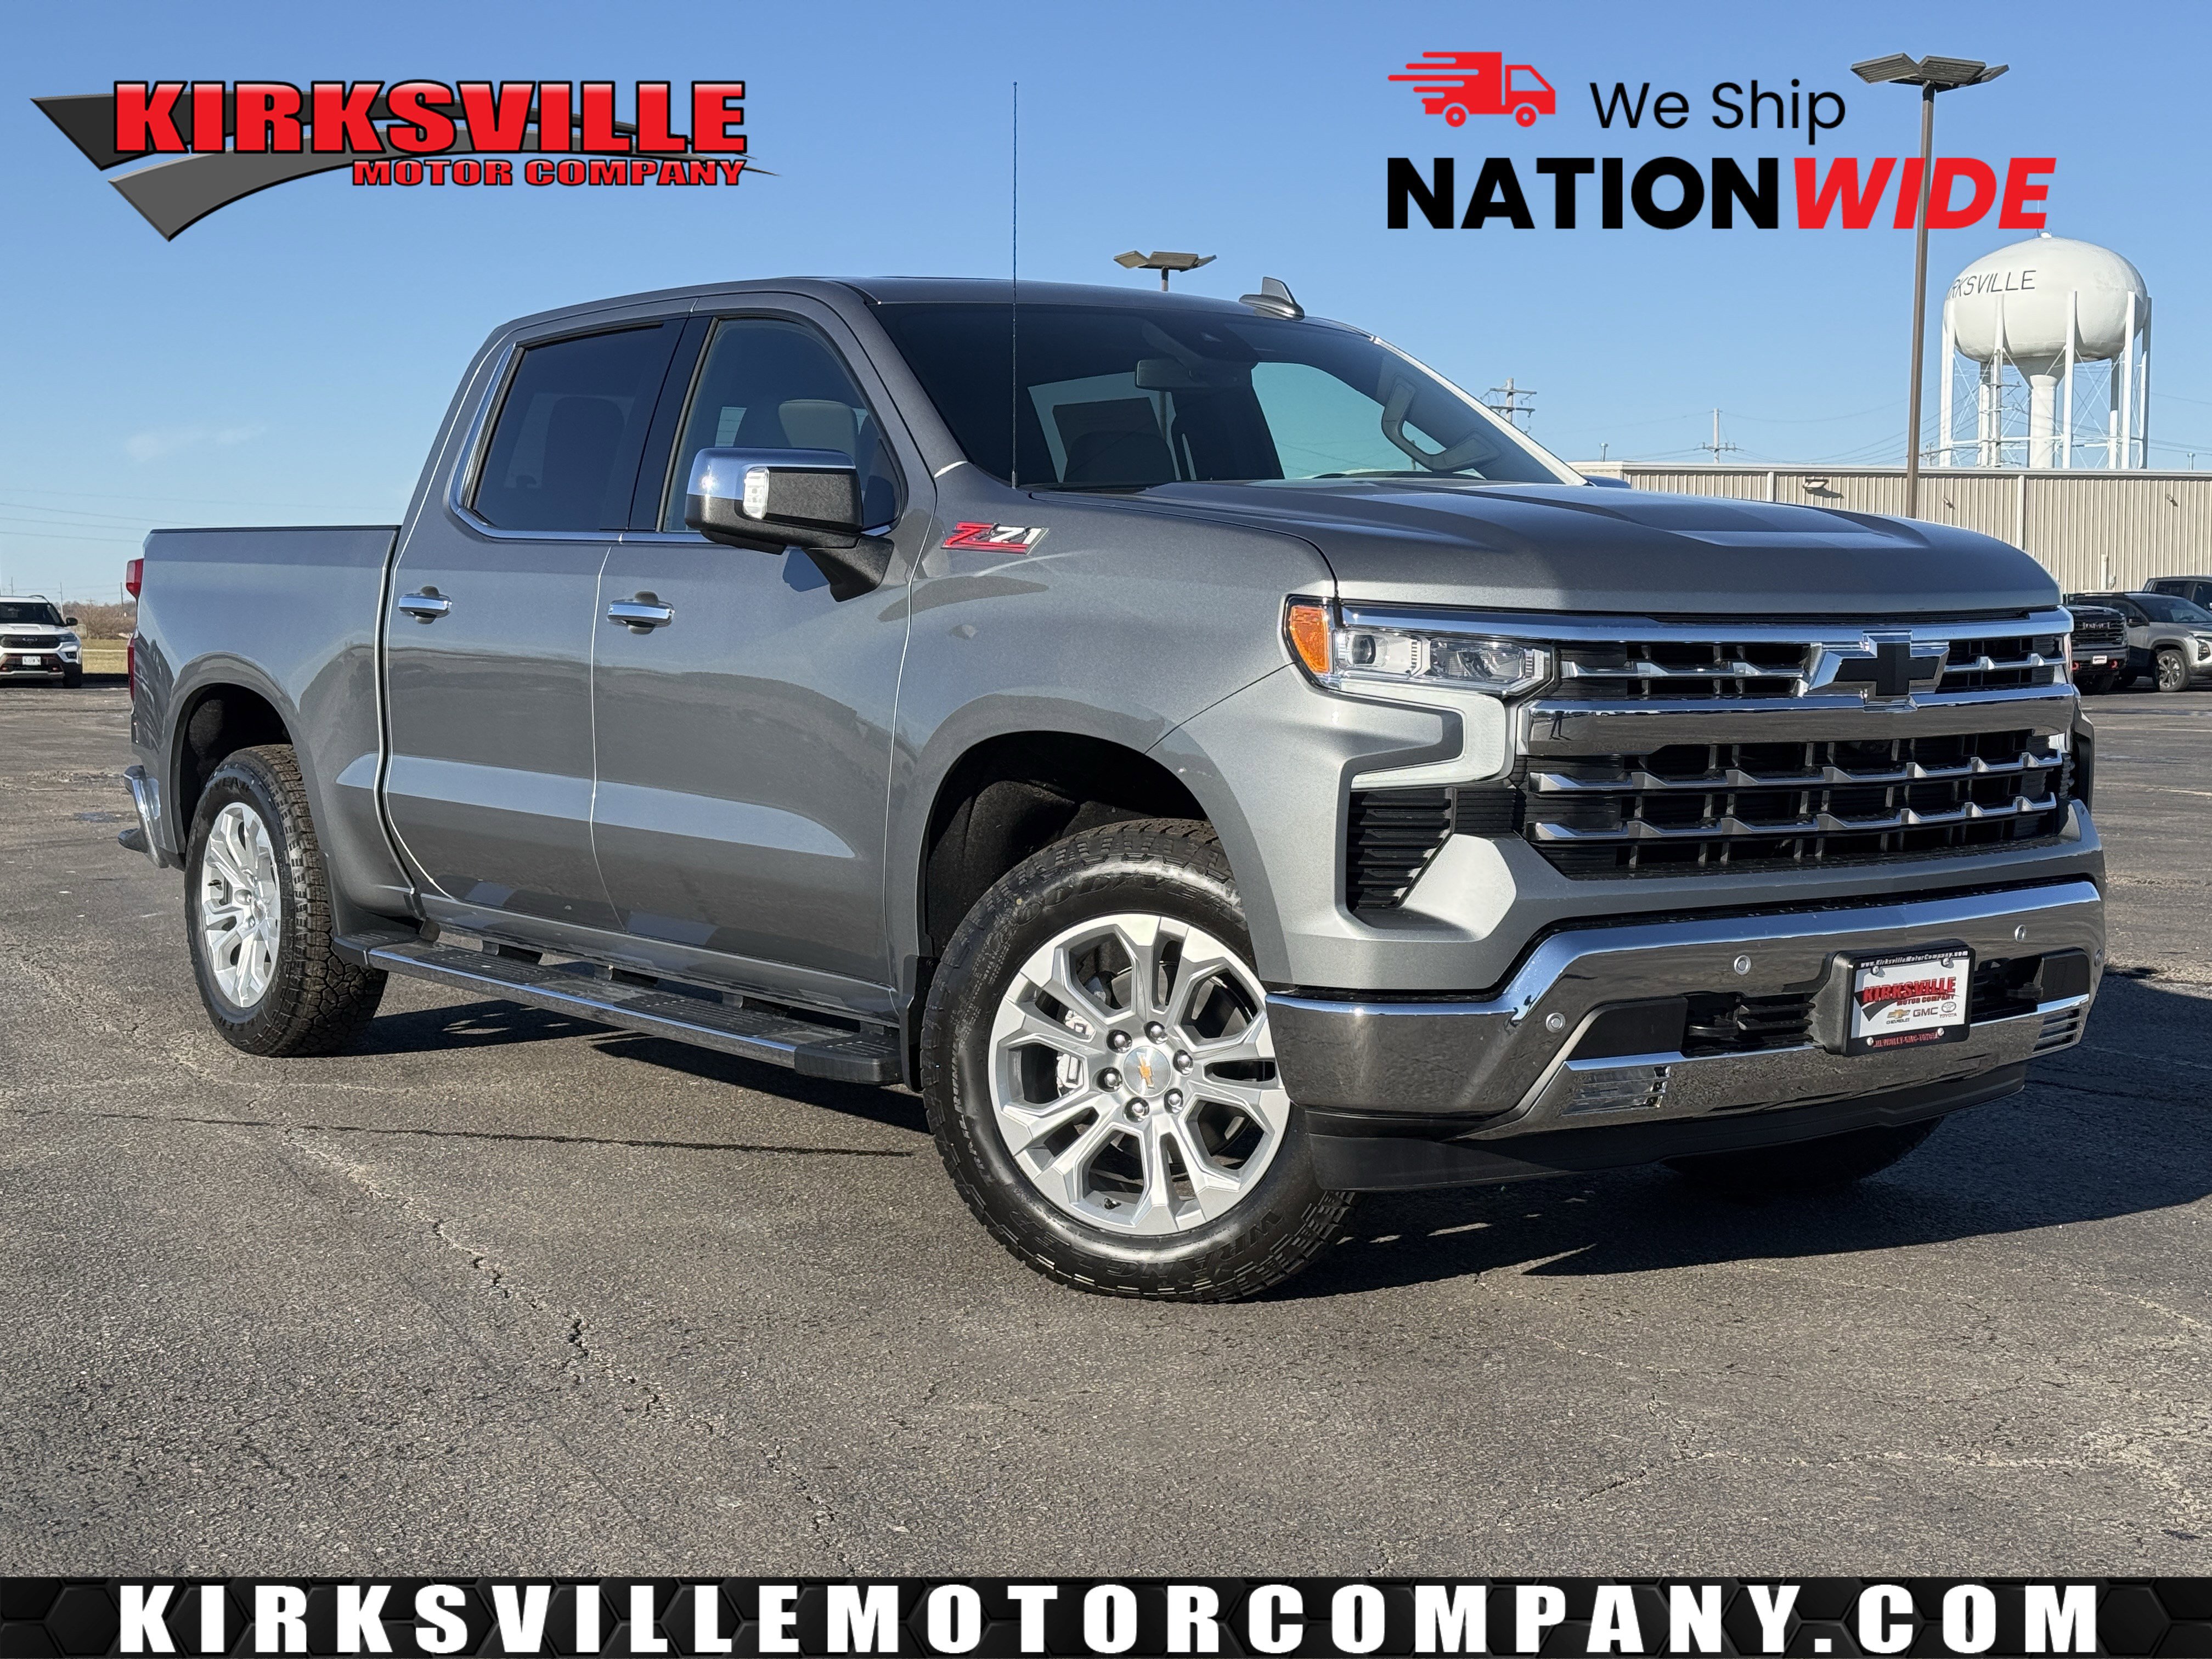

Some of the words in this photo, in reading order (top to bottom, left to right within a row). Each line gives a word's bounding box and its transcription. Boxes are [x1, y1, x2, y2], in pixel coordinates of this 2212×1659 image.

[1948, 269, 2037, 300] RKSVILLE
[941, 521, 1043, 554] Z71
[988, 871, 1246, 953] GOODYEA
[1862, 976, 1957, 1003] KIRKSVILLE
[1897, 997, 1921, 1006] MOTOR
[1921, 994, 1955, 1003] COMPANY
[1912, 1007, 1939, 1017] GMC
